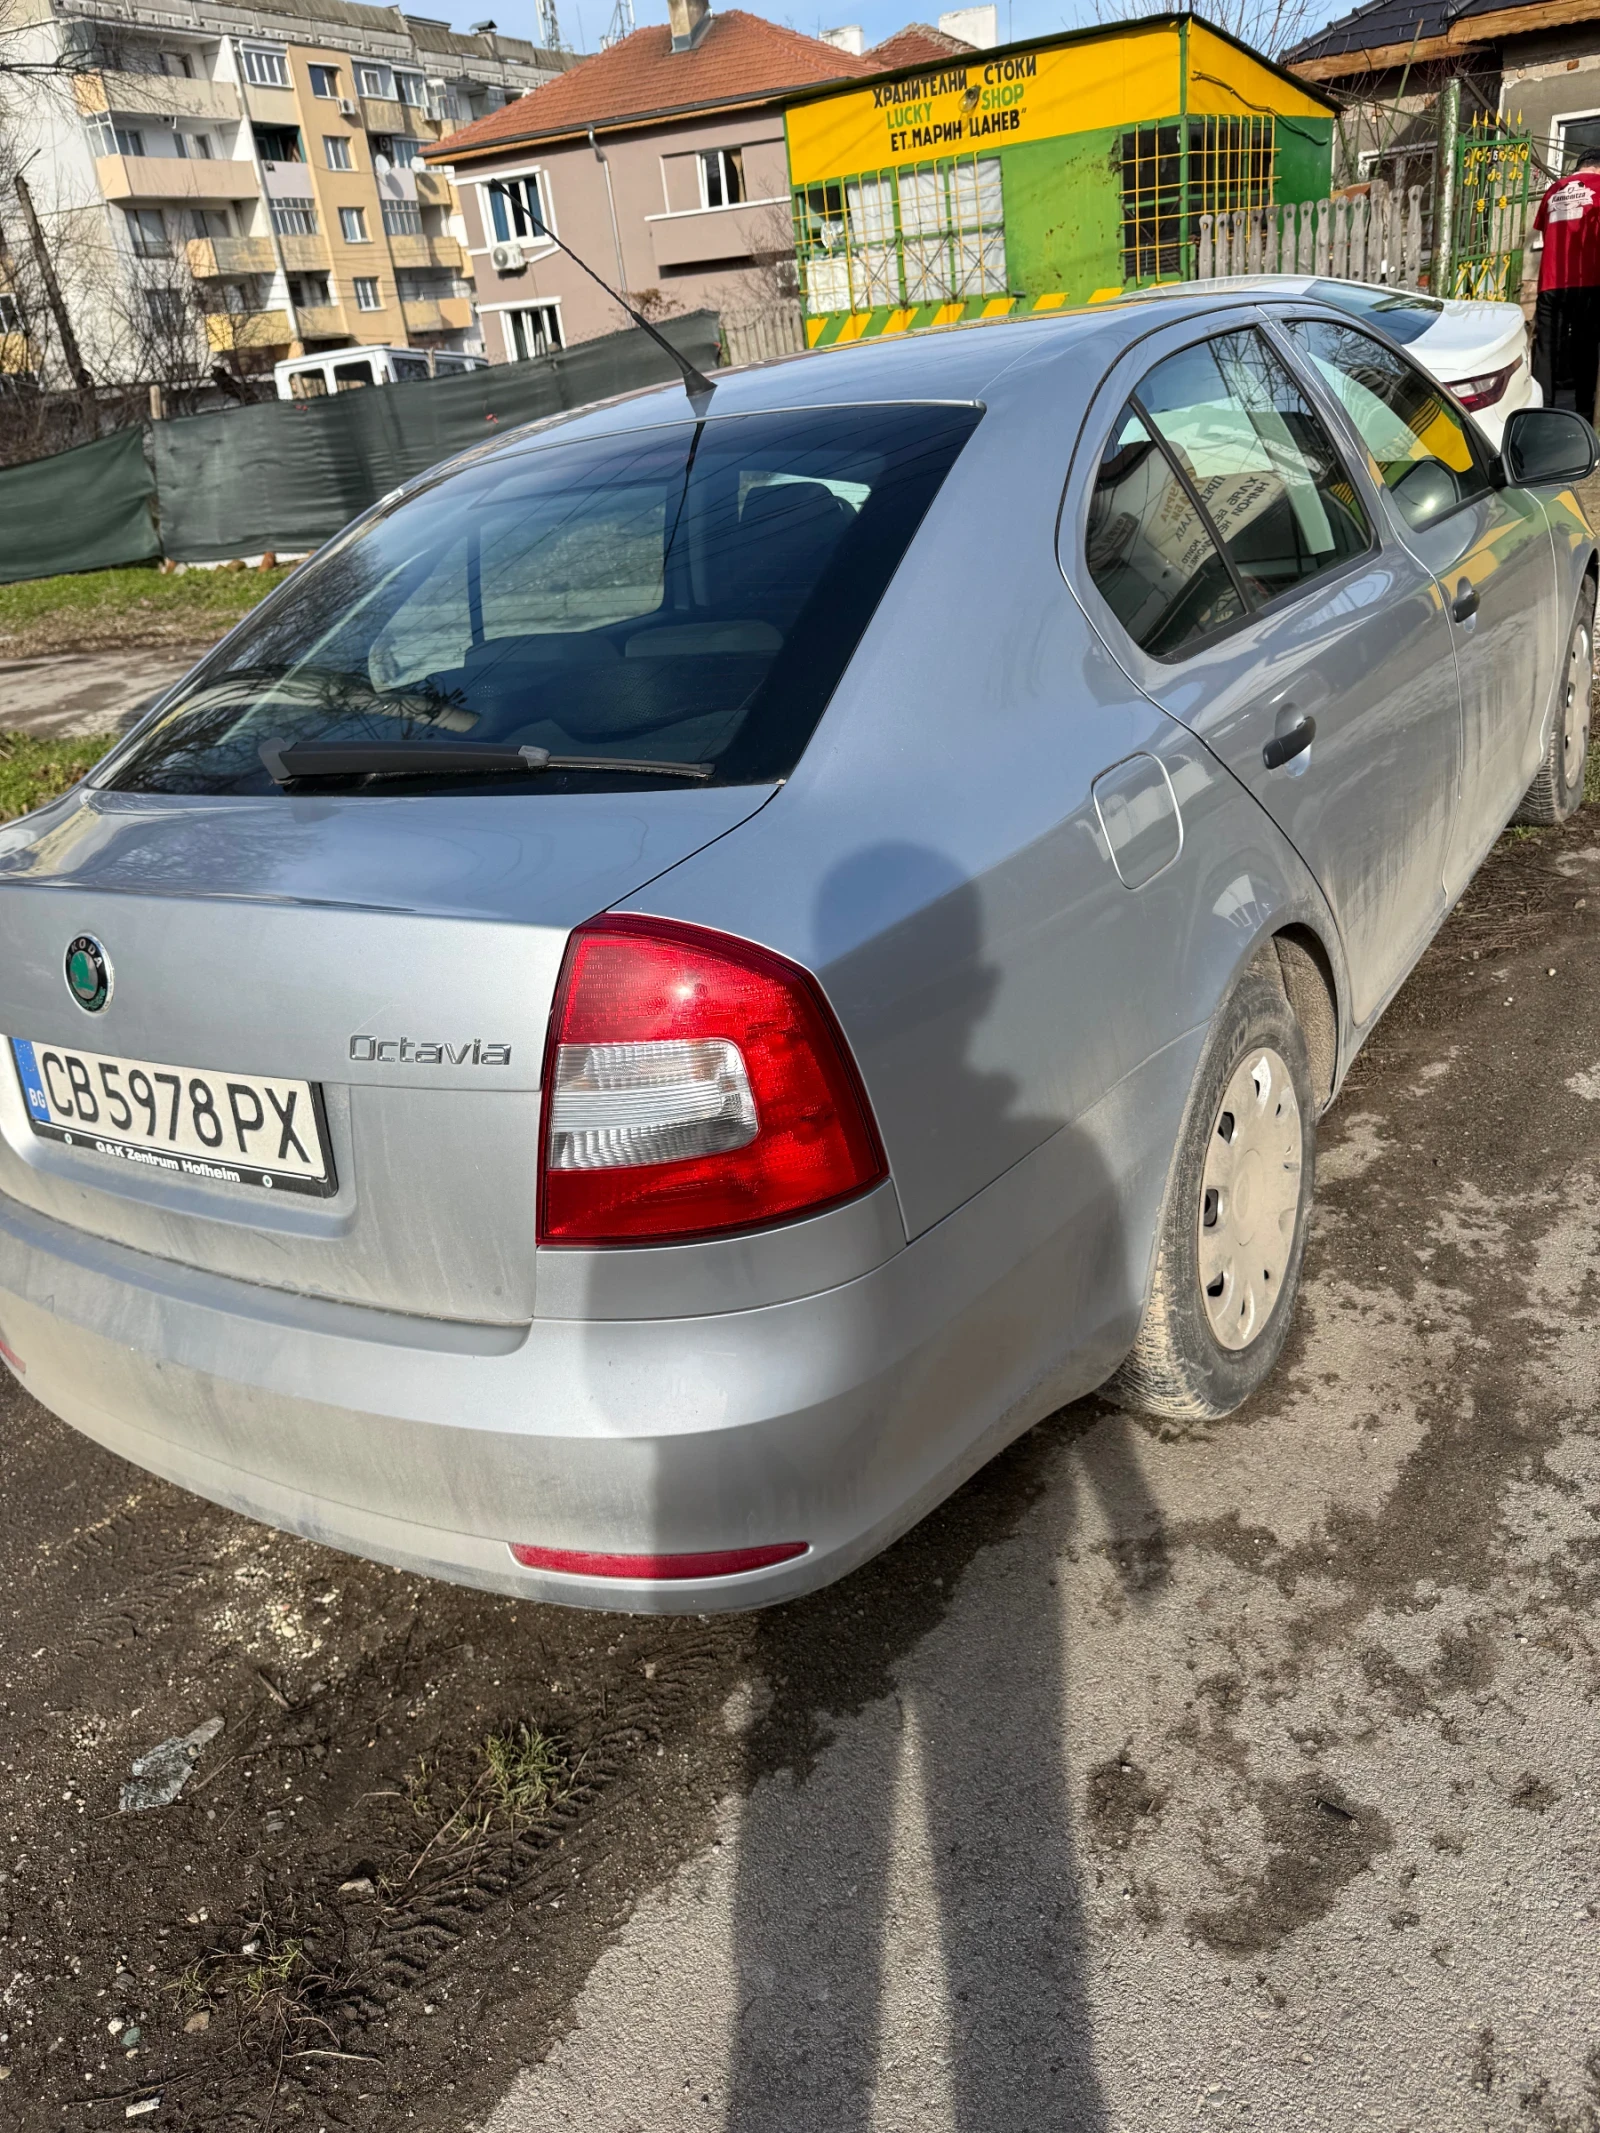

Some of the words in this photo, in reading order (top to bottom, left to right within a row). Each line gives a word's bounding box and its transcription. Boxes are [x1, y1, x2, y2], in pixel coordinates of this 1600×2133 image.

[872, 69, 968, 109] ХРАНИТЕЛНИ
[984, 55, 1037, 85] СТОКИ
[886, 101, 933, 130] LUCKY
[981, 83, 1025, 110] SHOP
[350, 1034, 512, 1066] Octavia
[28, 1088, 47, 1110] BG
[125, 1147, 180, 1171] Zentrum
[181, 1160, 241, 1183] Hofheim
